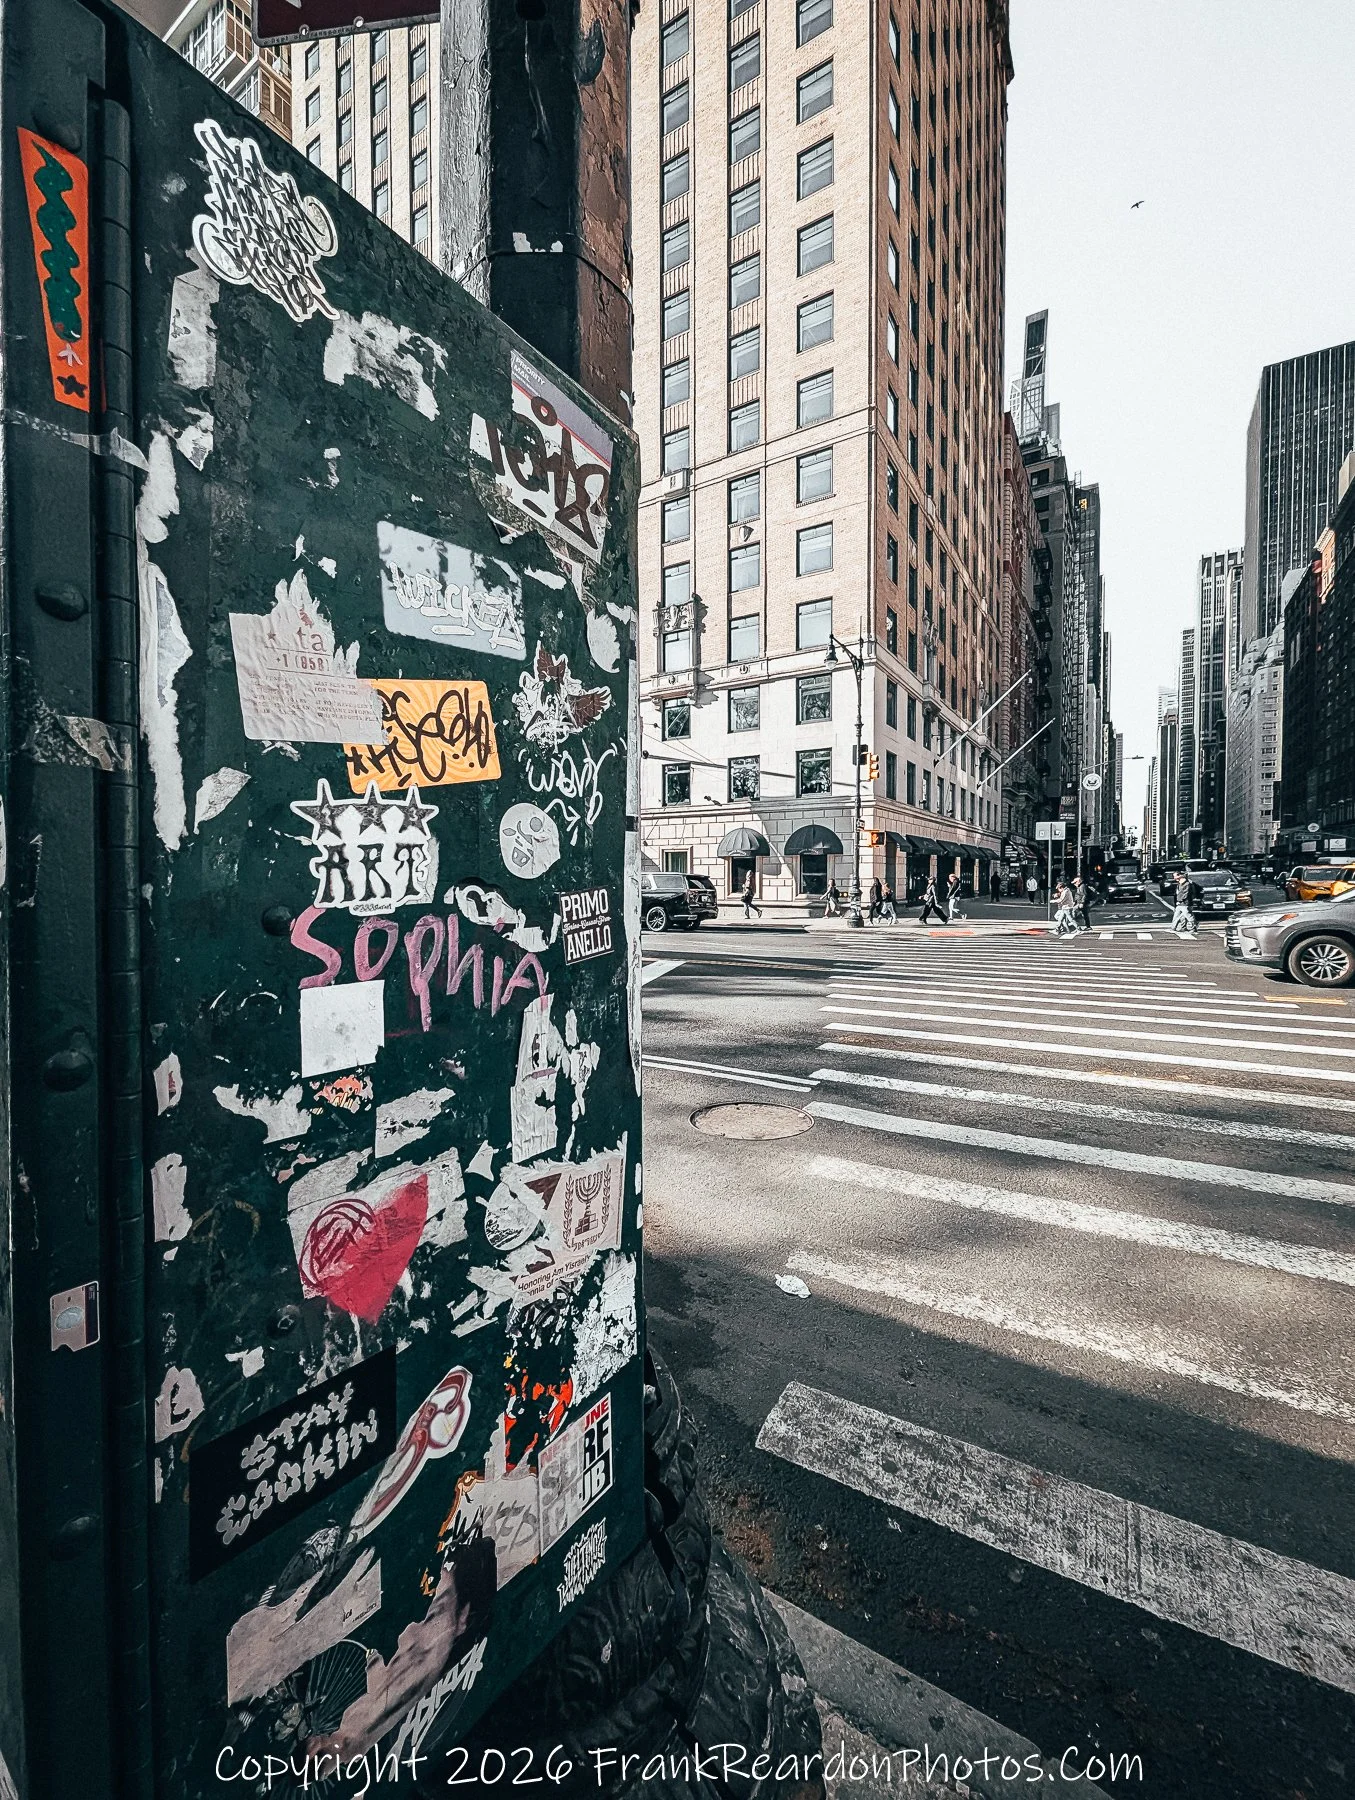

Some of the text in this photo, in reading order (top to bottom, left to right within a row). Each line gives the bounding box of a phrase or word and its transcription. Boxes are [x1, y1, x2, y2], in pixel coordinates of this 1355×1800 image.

[513, 364, 531, 383] MAIL
[514, 356, 546, 386] PRIORITY
[561, 888, 609, 923] PRIMO
[565, 924, 612, 961] ANELLO
[241, 1382, 354, 1480] STAY
